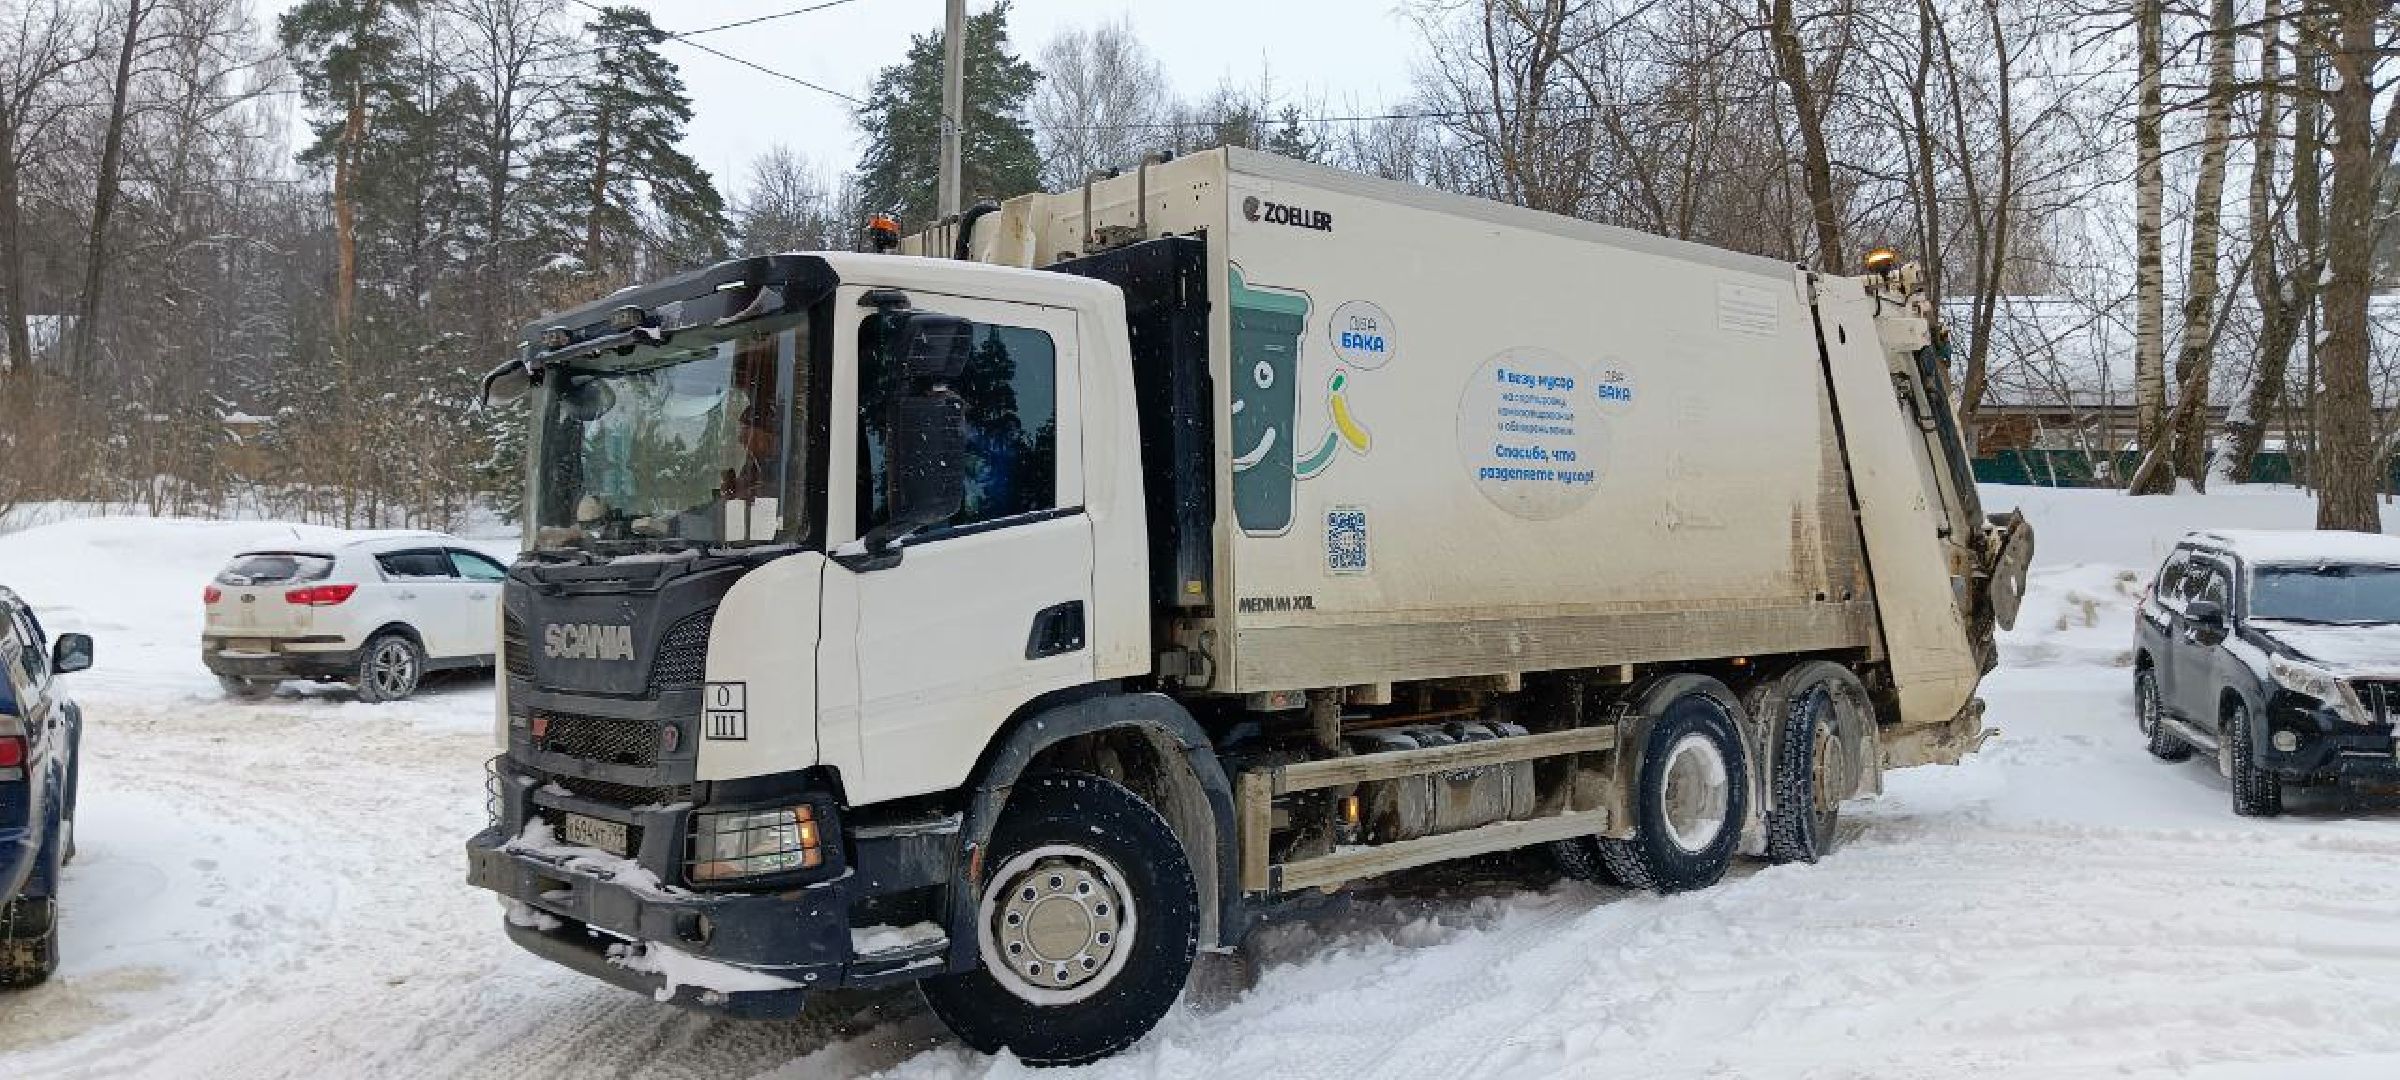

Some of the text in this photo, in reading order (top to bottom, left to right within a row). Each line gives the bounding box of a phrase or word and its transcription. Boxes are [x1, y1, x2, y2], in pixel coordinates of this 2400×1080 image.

[1263, 201, 1332, 232] ZOELLER
[1341, 332, 1384, 353] БАКА
[1497, 368, 1574, 391] Я везу мусор
[1598, 385, 1632, 402] БАКА
[1495, 444, 1576, 463] Спасибо, что
[1479, 467, 1594, 485] разделяете мусор!
[1238, 595, 1317, 614] MEDIUM XXL
[544, 622, 636, 662] SCANIA
